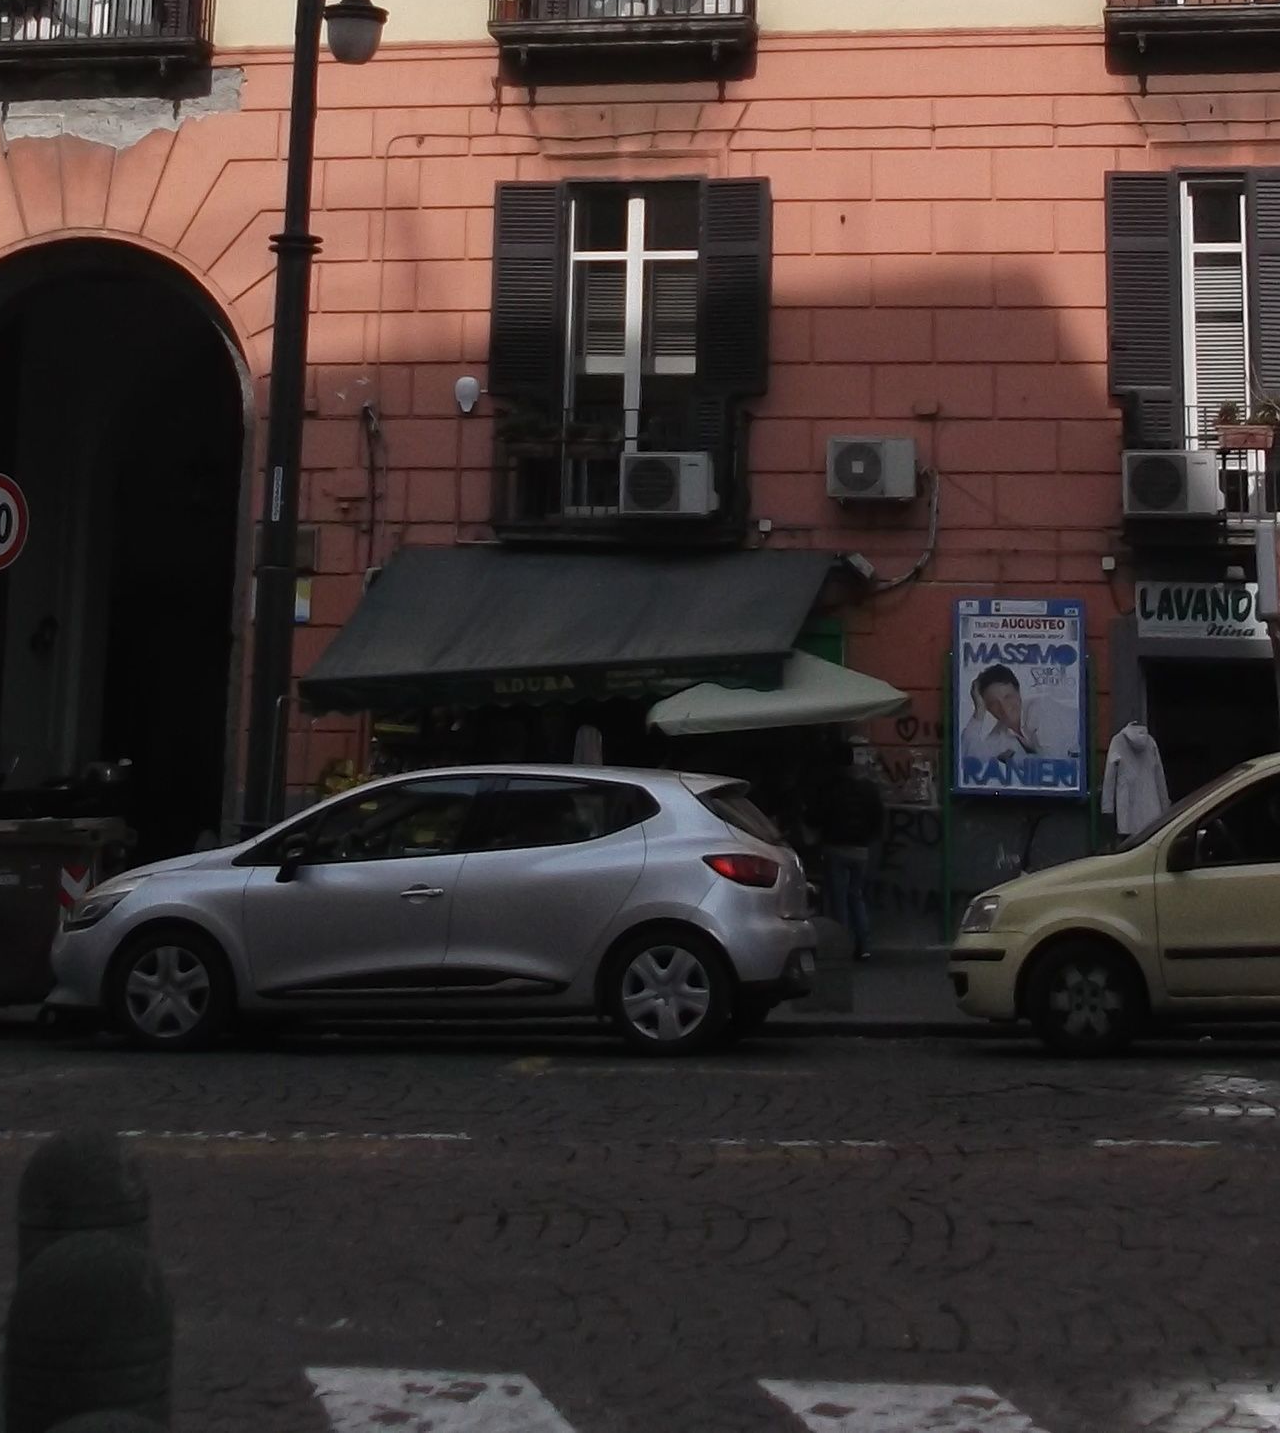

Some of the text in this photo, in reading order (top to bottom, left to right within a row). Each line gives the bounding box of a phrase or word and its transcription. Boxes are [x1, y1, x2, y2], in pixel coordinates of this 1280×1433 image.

[1001, 618, 1065, 630] AUGUSTEO
[1205, 622, 1256, 637] Nina
[962, 641, 1078, 666] MASSIMO
[961, 755, 1079, 788] RANIERI
